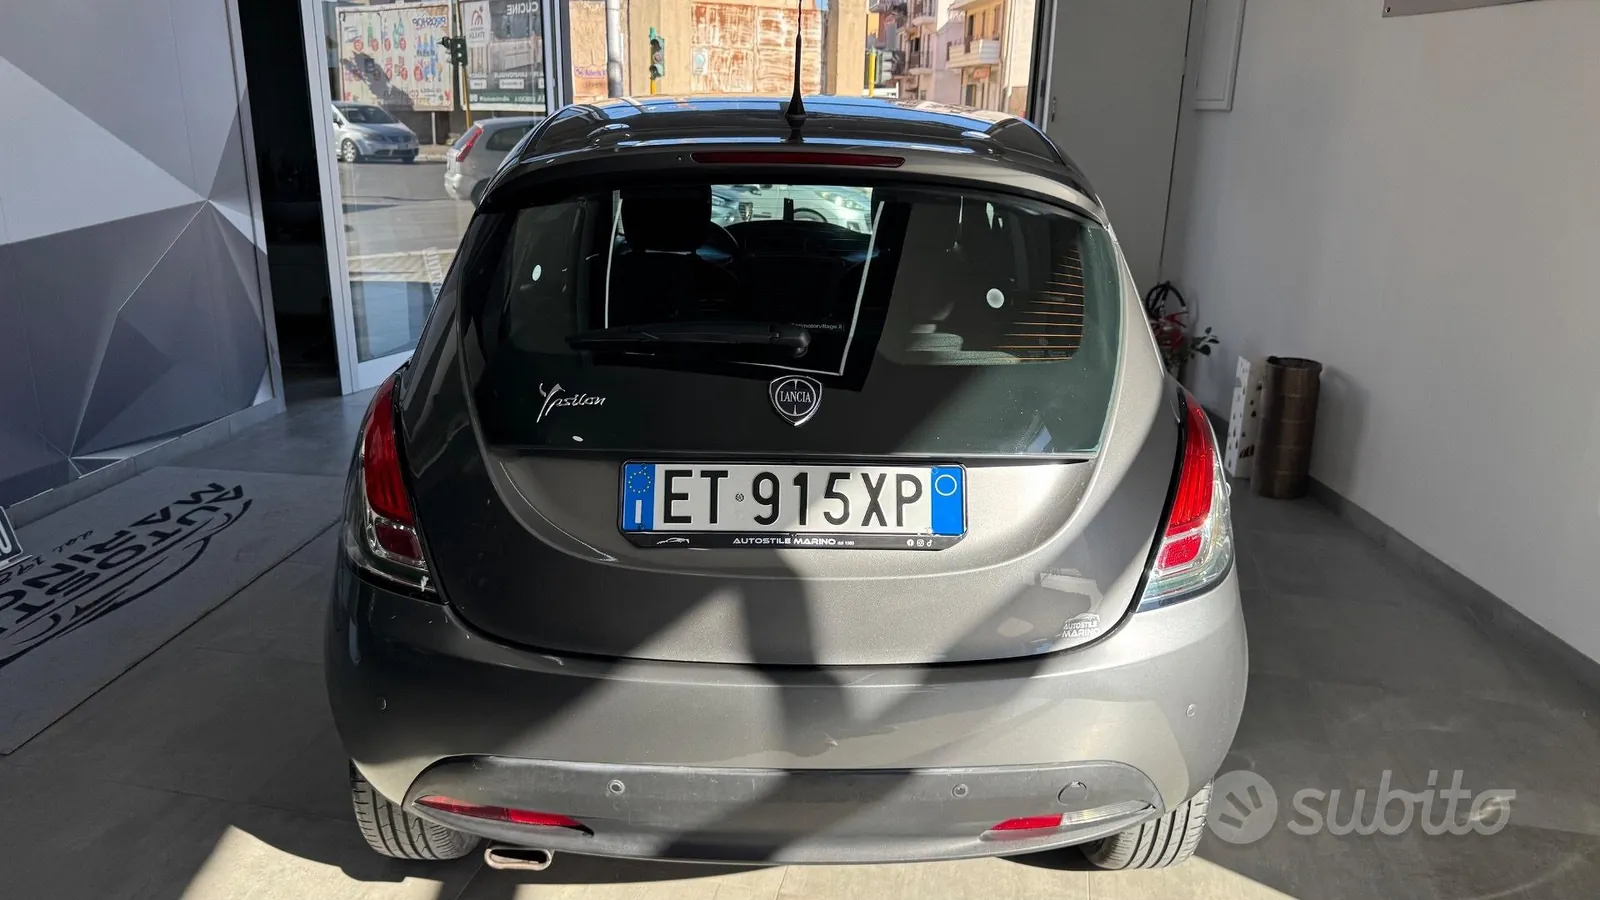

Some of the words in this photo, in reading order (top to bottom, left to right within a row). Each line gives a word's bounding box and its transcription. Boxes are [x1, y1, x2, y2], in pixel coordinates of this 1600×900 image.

[536, 382, 606, 423] Ypsilon
[780, 391, 812, 403] LANCIA
[663, 469, 729, 524] ET
[752, 471, 923, 528] 915XP
[733, 537, 791, 545] AUTOSTILE
[0, 484, 246, 635] AUTOST
[1063, 621, 1098, 630] AUTOSTILE
[1062, 628, 1100, 638] MARINO
